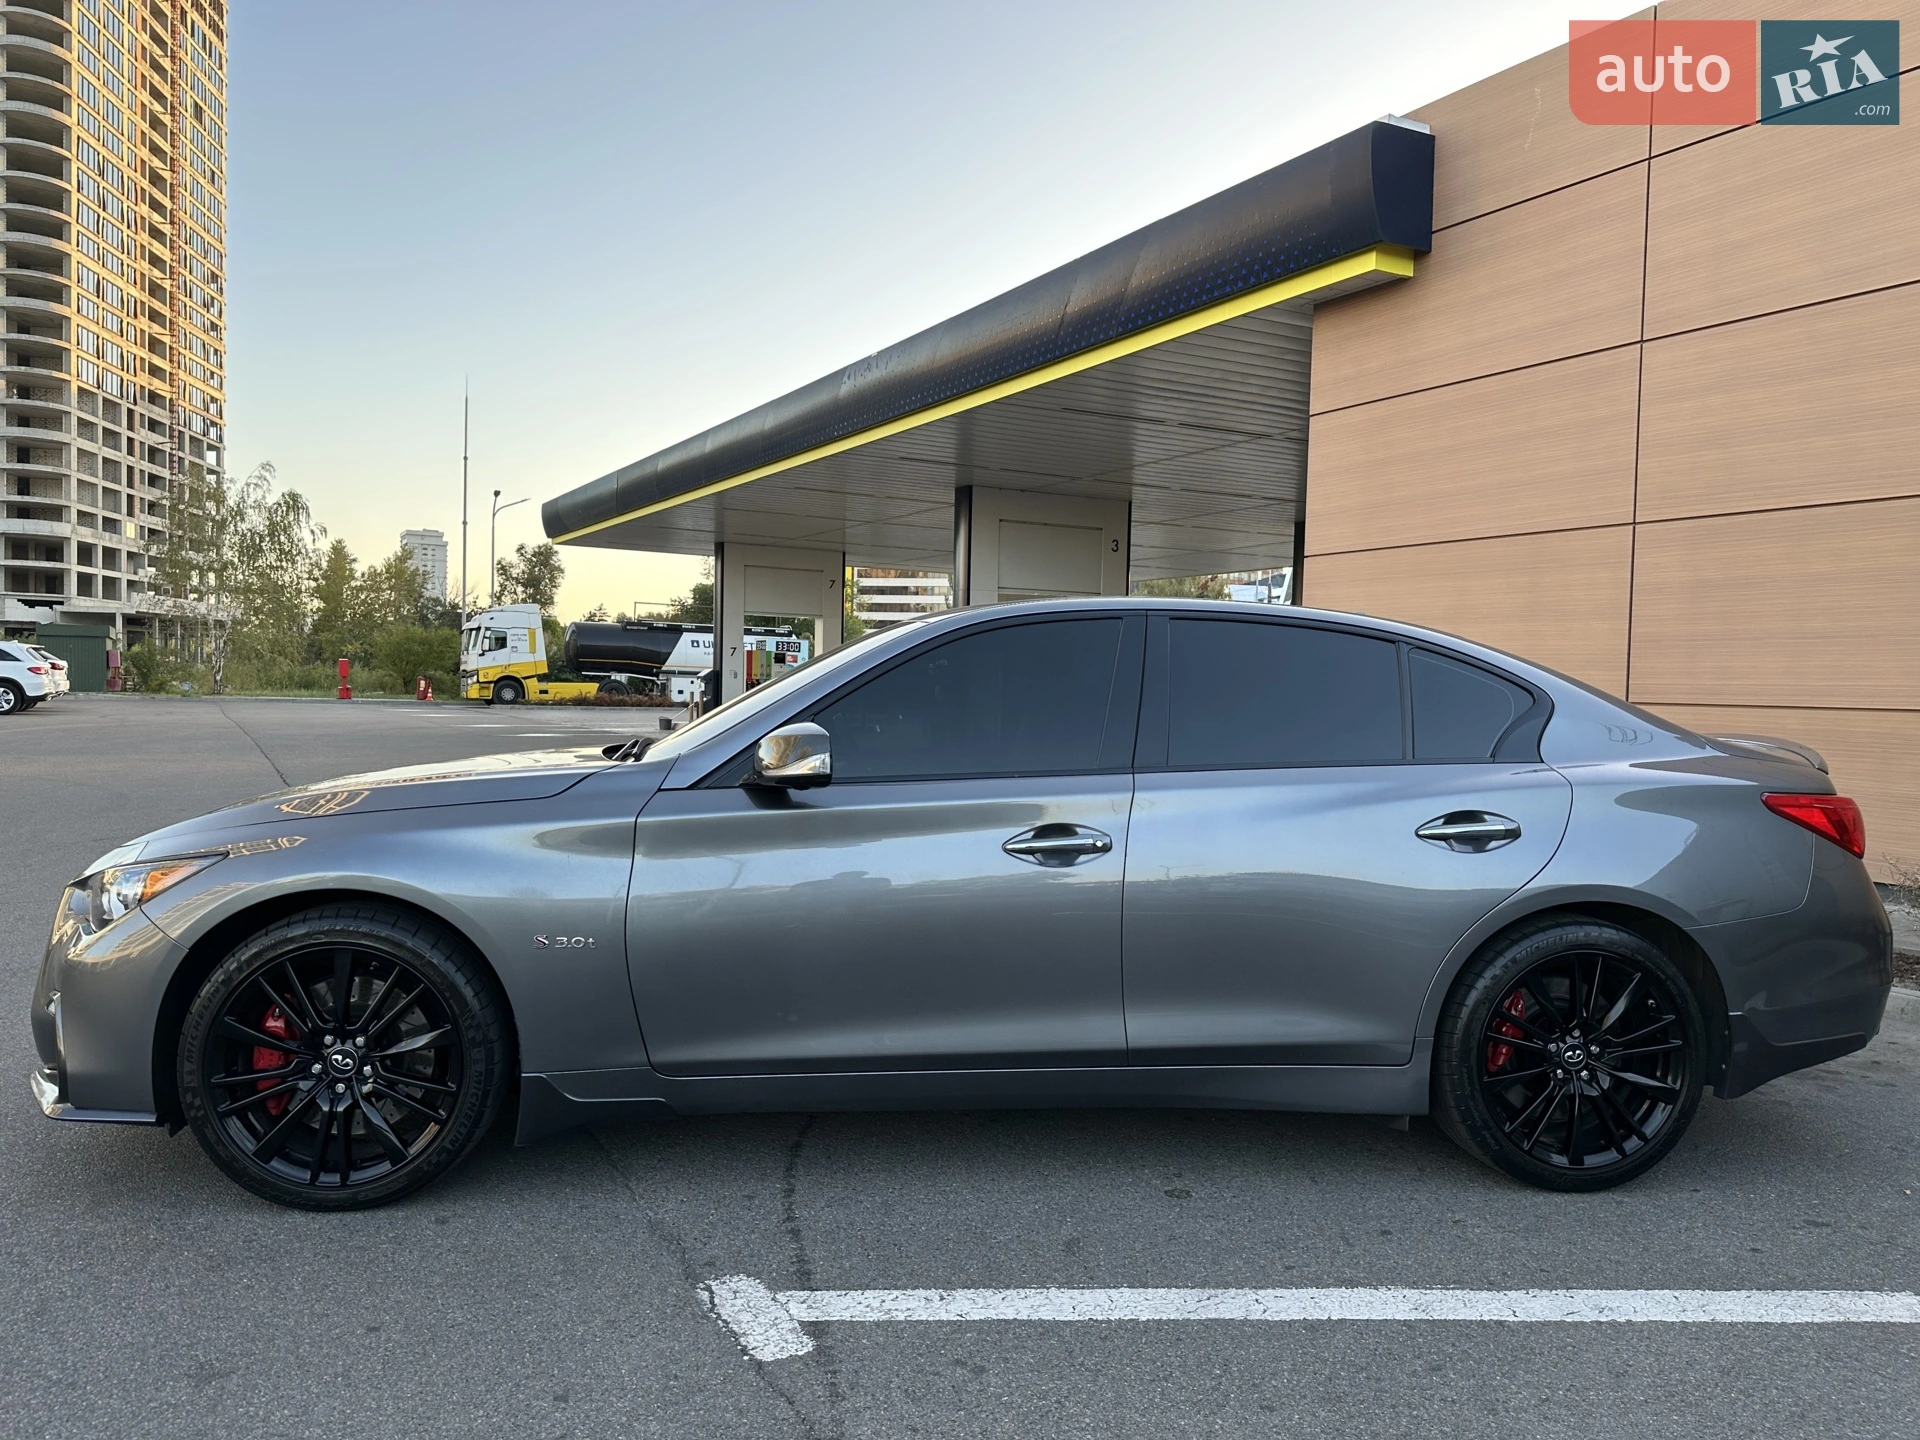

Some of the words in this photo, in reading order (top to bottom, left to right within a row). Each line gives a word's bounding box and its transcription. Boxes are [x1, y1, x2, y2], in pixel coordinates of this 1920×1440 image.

[1111, 539, 1119, 552] 3
[829, 580, 836, 589] 7
[730, 647, 737, 657] 7
[777, 641, 800, 652] 33:00
[555, 936, 597, 949] 3.0t
[1515, 933, 1578, 961] MICHELIN
[185, 984, 224, 1064] MICHELIN
[447, 1069, 485, 1150] MICHELIN
